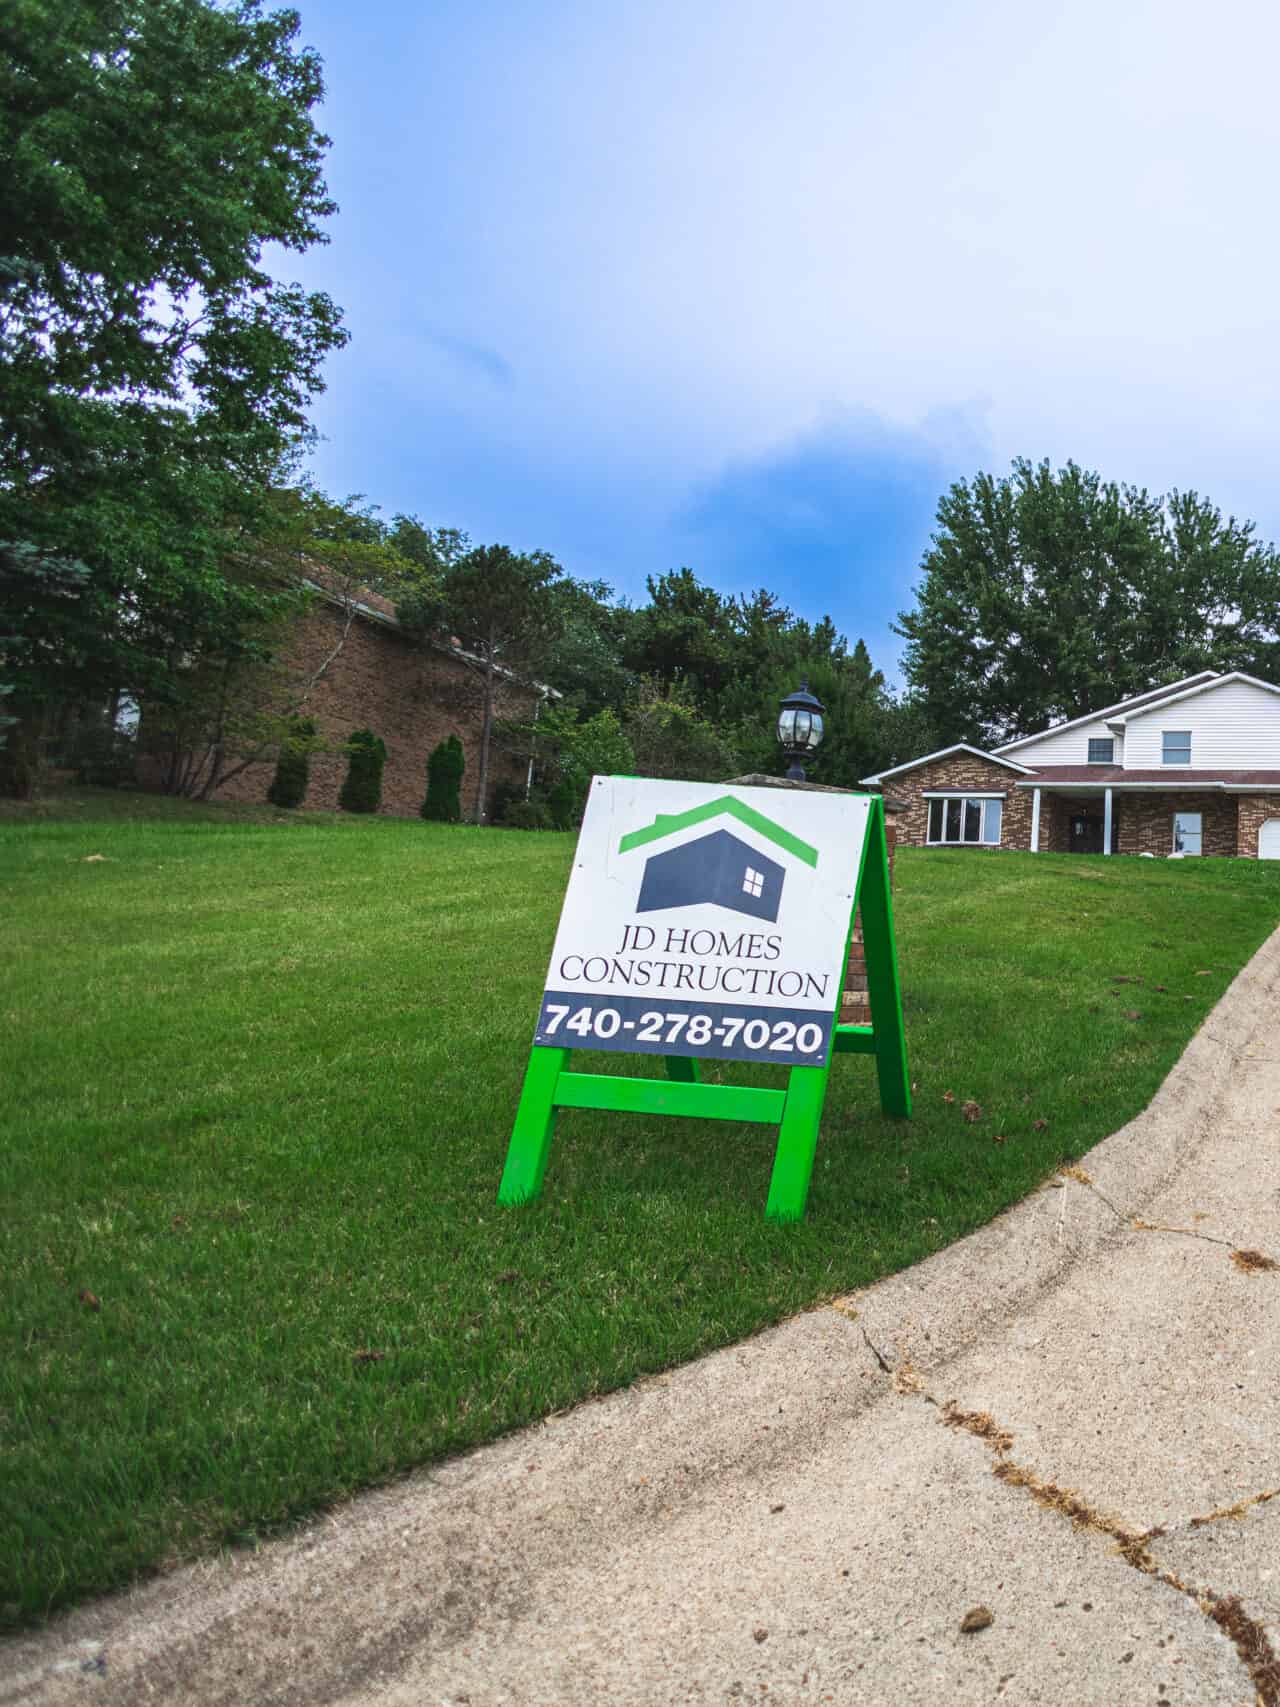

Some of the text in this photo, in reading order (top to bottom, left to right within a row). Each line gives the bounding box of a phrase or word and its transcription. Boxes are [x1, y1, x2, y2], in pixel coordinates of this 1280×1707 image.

[617, 925, 782, 959] JD HOMES
[560, 956, 829, 998] CONSTRUCTION
[544, 1005, 823, 1053] 740-278-7020
